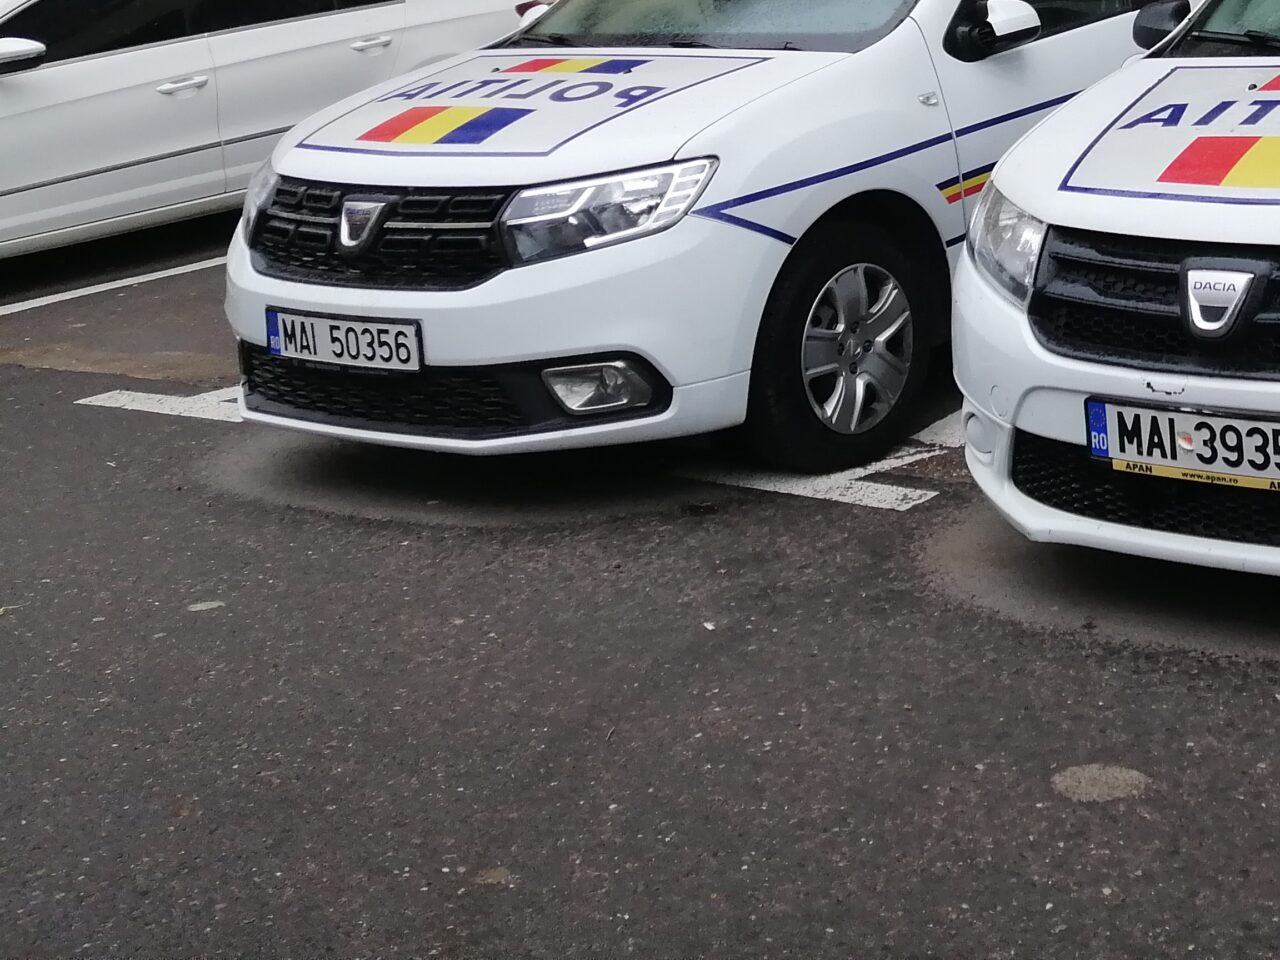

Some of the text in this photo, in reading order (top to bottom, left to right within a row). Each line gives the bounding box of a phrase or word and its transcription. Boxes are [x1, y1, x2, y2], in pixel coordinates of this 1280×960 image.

[1193, 281, 1237, 293] DACIA
[282, 318, 411, 365] MAI 50356
[1091, 431, 1107, 451] RO
[1117, 411, 1178, 461] MAI
[1125, 462, 1153, 474] APAN
[1181, 471, 1239, 484] www.apan.ro
